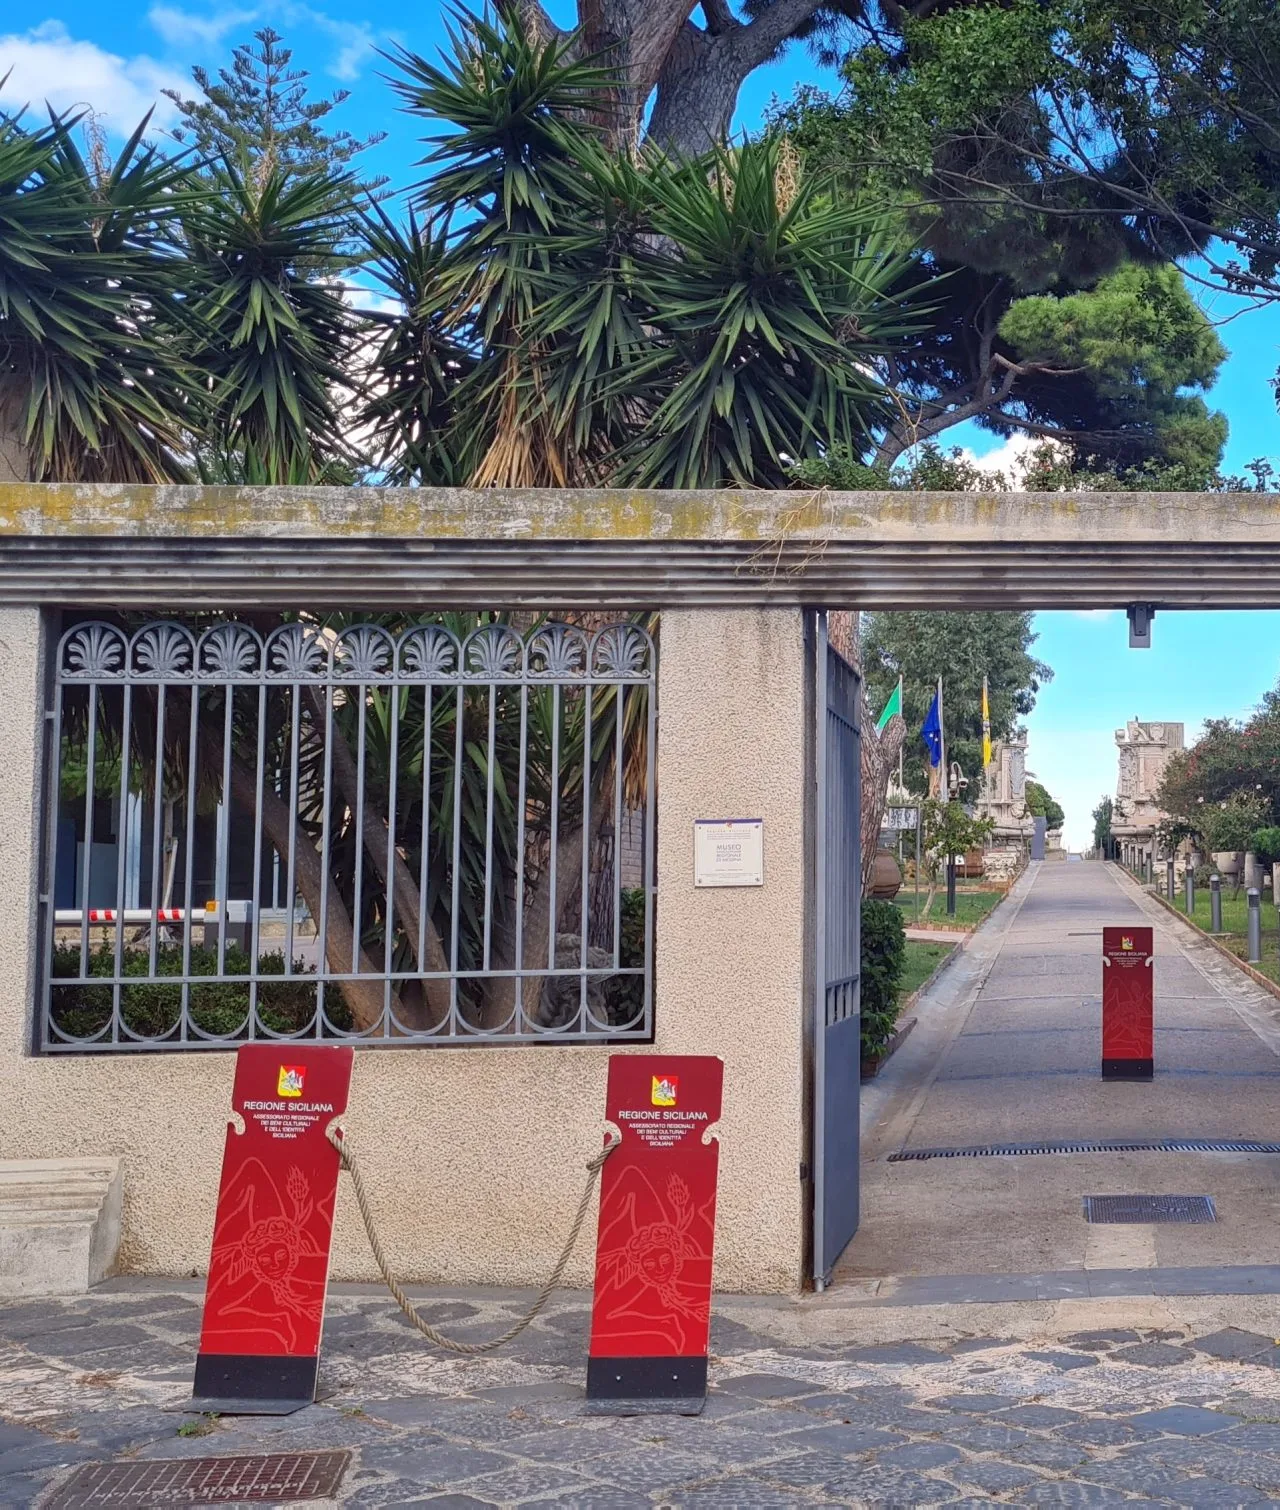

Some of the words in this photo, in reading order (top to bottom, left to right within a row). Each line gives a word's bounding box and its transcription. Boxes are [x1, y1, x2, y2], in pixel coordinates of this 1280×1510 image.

[243, 1101, 286, 1110] REGIONE
[288, 1102, 334, 1112] SICILIANA
[618, 1111, 660, 1120] REGIONE
[663, 1112, 708, 1120] SICILIANA
